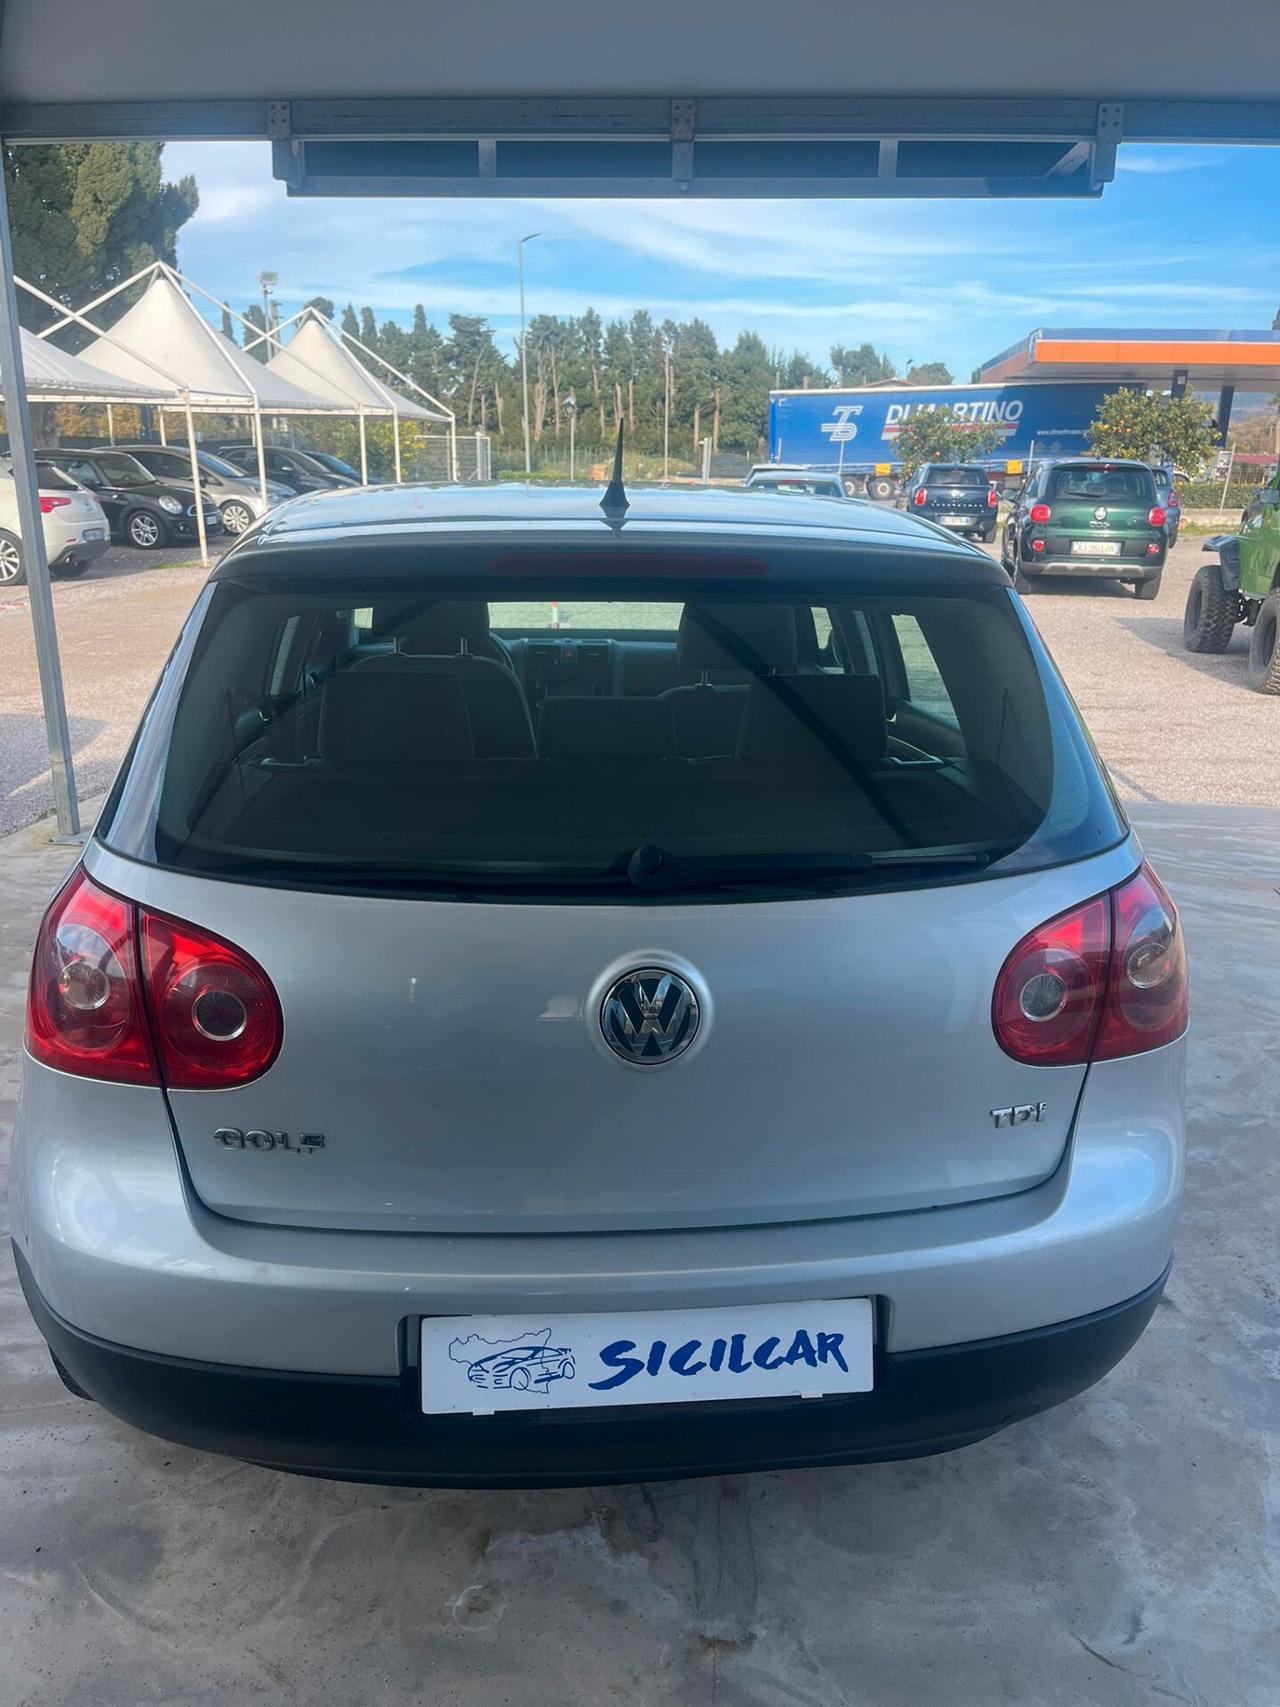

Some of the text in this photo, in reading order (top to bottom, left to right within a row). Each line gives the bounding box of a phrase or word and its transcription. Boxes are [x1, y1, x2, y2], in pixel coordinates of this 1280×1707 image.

[885, 404, 911, 424] DI
[213, 1126, 326, 1155] GOLF
[588, 1329, 849, 1391] SICILCAR
